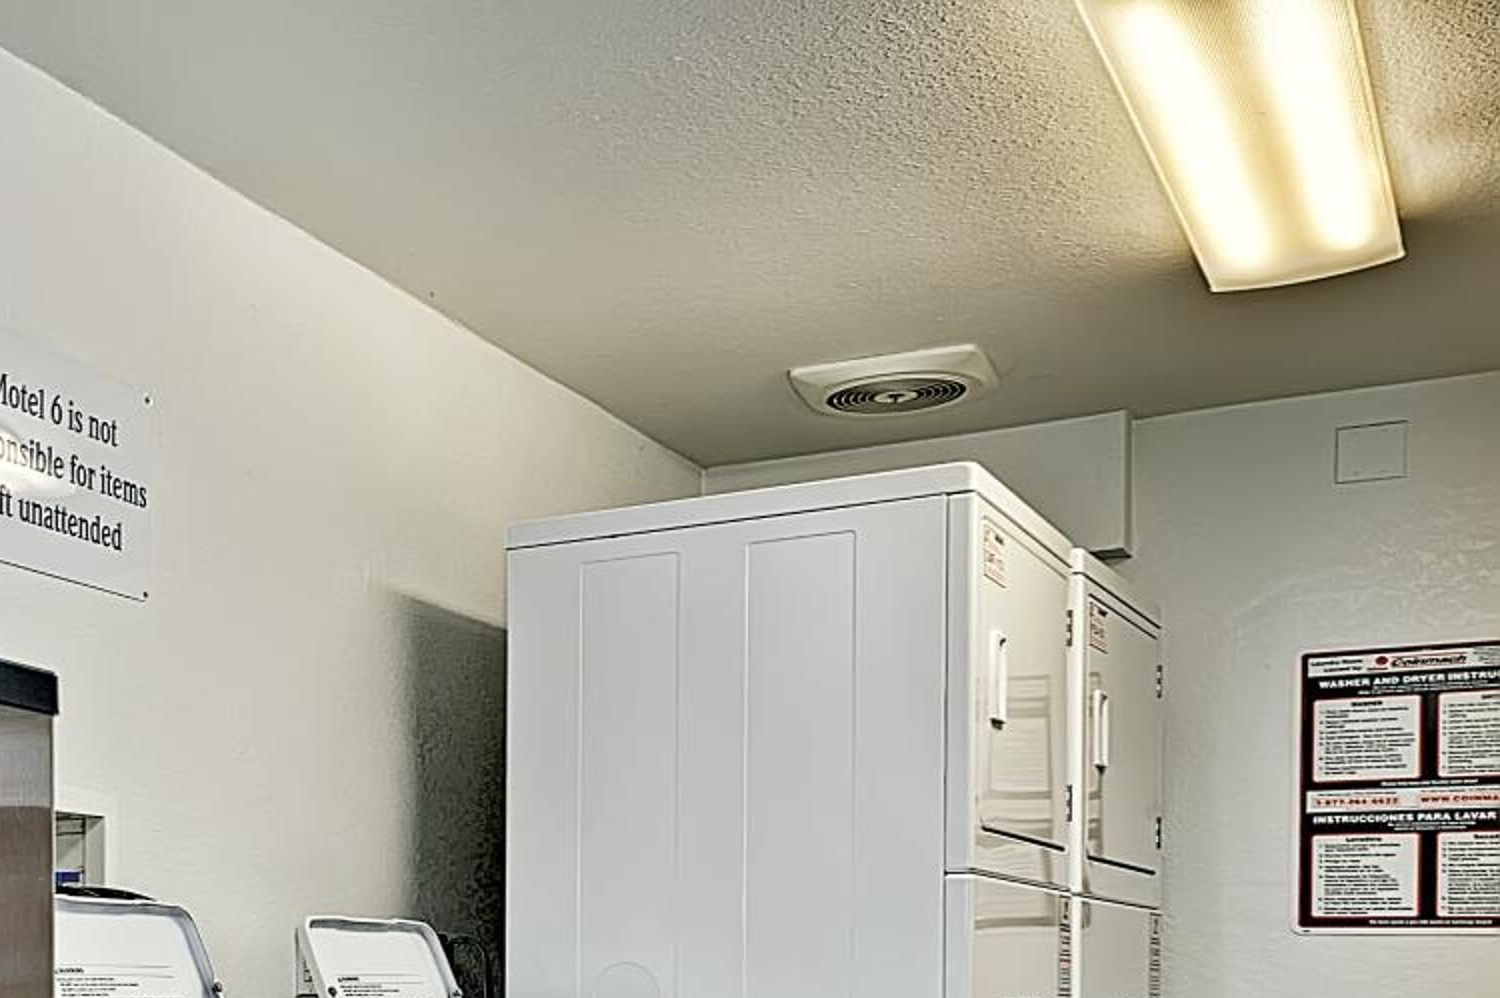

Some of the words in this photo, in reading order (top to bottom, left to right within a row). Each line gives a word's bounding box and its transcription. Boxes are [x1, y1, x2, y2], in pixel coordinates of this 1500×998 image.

[51, 394, 63, 425] 6
[68, 400, 83, 433] is
[88, 415, 120, 447] not
[70, 454, 96, 490] for
[100, 465, 148, 508] items
[18, 498, 123, 551] unattended
[1318, 678, 1371, 689] WASHER
[1373, 675, 1400, 686] AND
[1403, 673, 1445, 684] DRYER
[1312, 812, 1414, 825] INSTRUCCIONES
[1417, 812, 1451, 822] PARA
[1454, 810, 1497, 820] LAVAR
